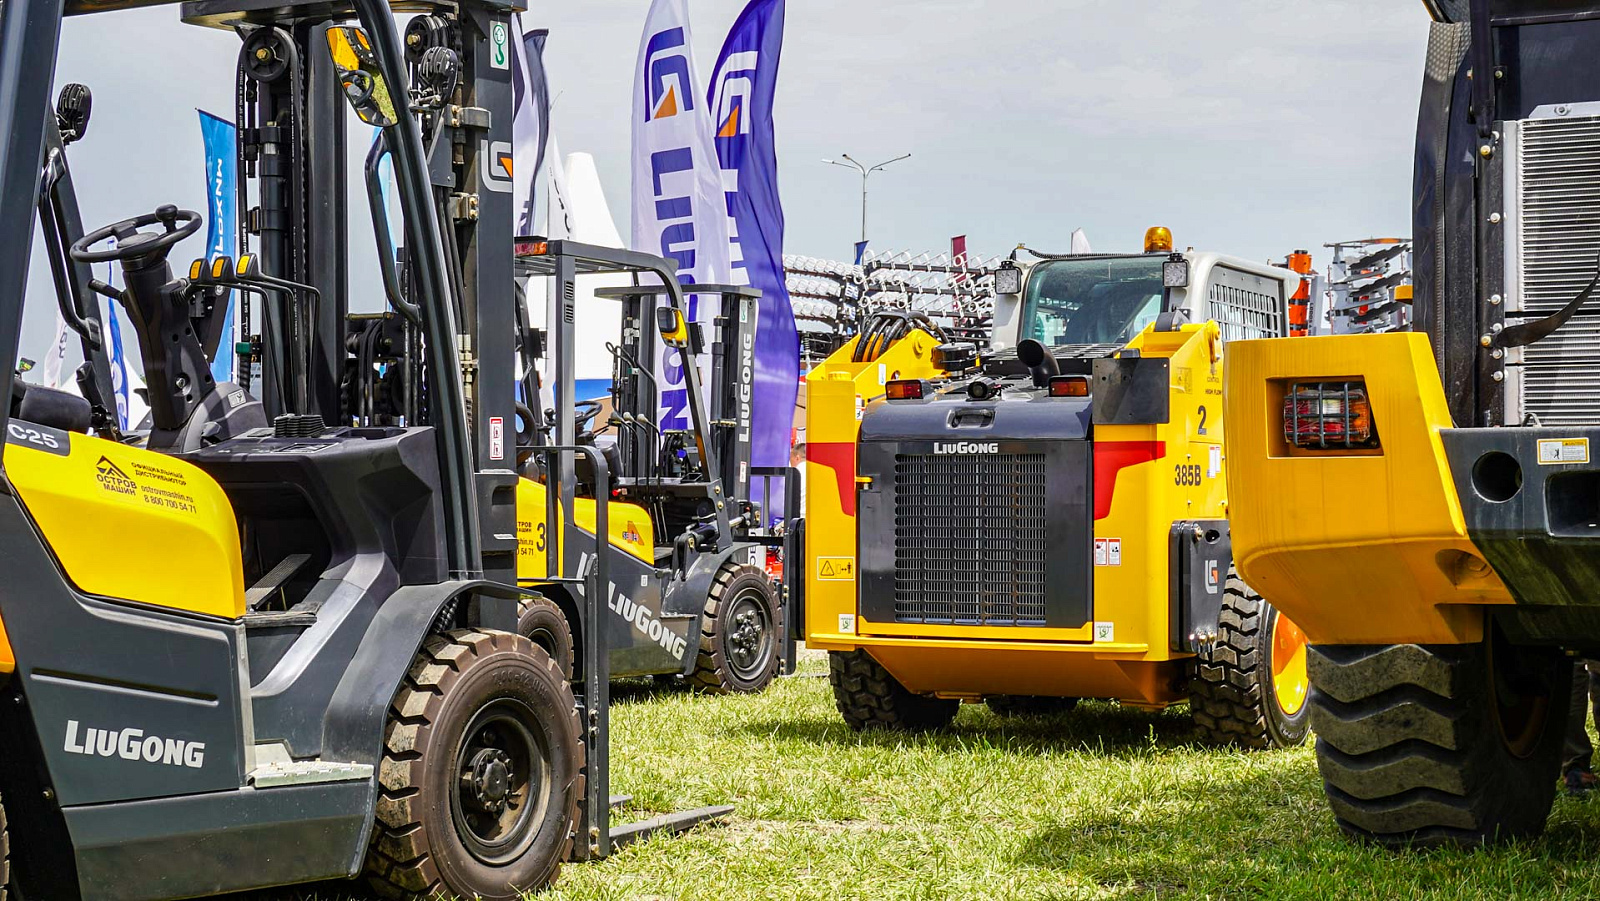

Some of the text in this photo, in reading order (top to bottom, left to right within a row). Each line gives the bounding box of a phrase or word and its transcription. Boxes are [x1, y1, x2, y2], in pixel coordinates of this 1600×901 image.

[1197, 405, 1207, 435] 2
[8, 424, 59, 449] C25
[96, 473, 138, 489] ОСТРОВ
[1174, 464, 1202, 486] 385B
[103, 483, 136, 496] МАШИН
[141, 485, 194, 503] ostrovmashin.ru
[144, 494, 197, 514] 8 800 700 54 71
[536, 522, 546, 552] 3
